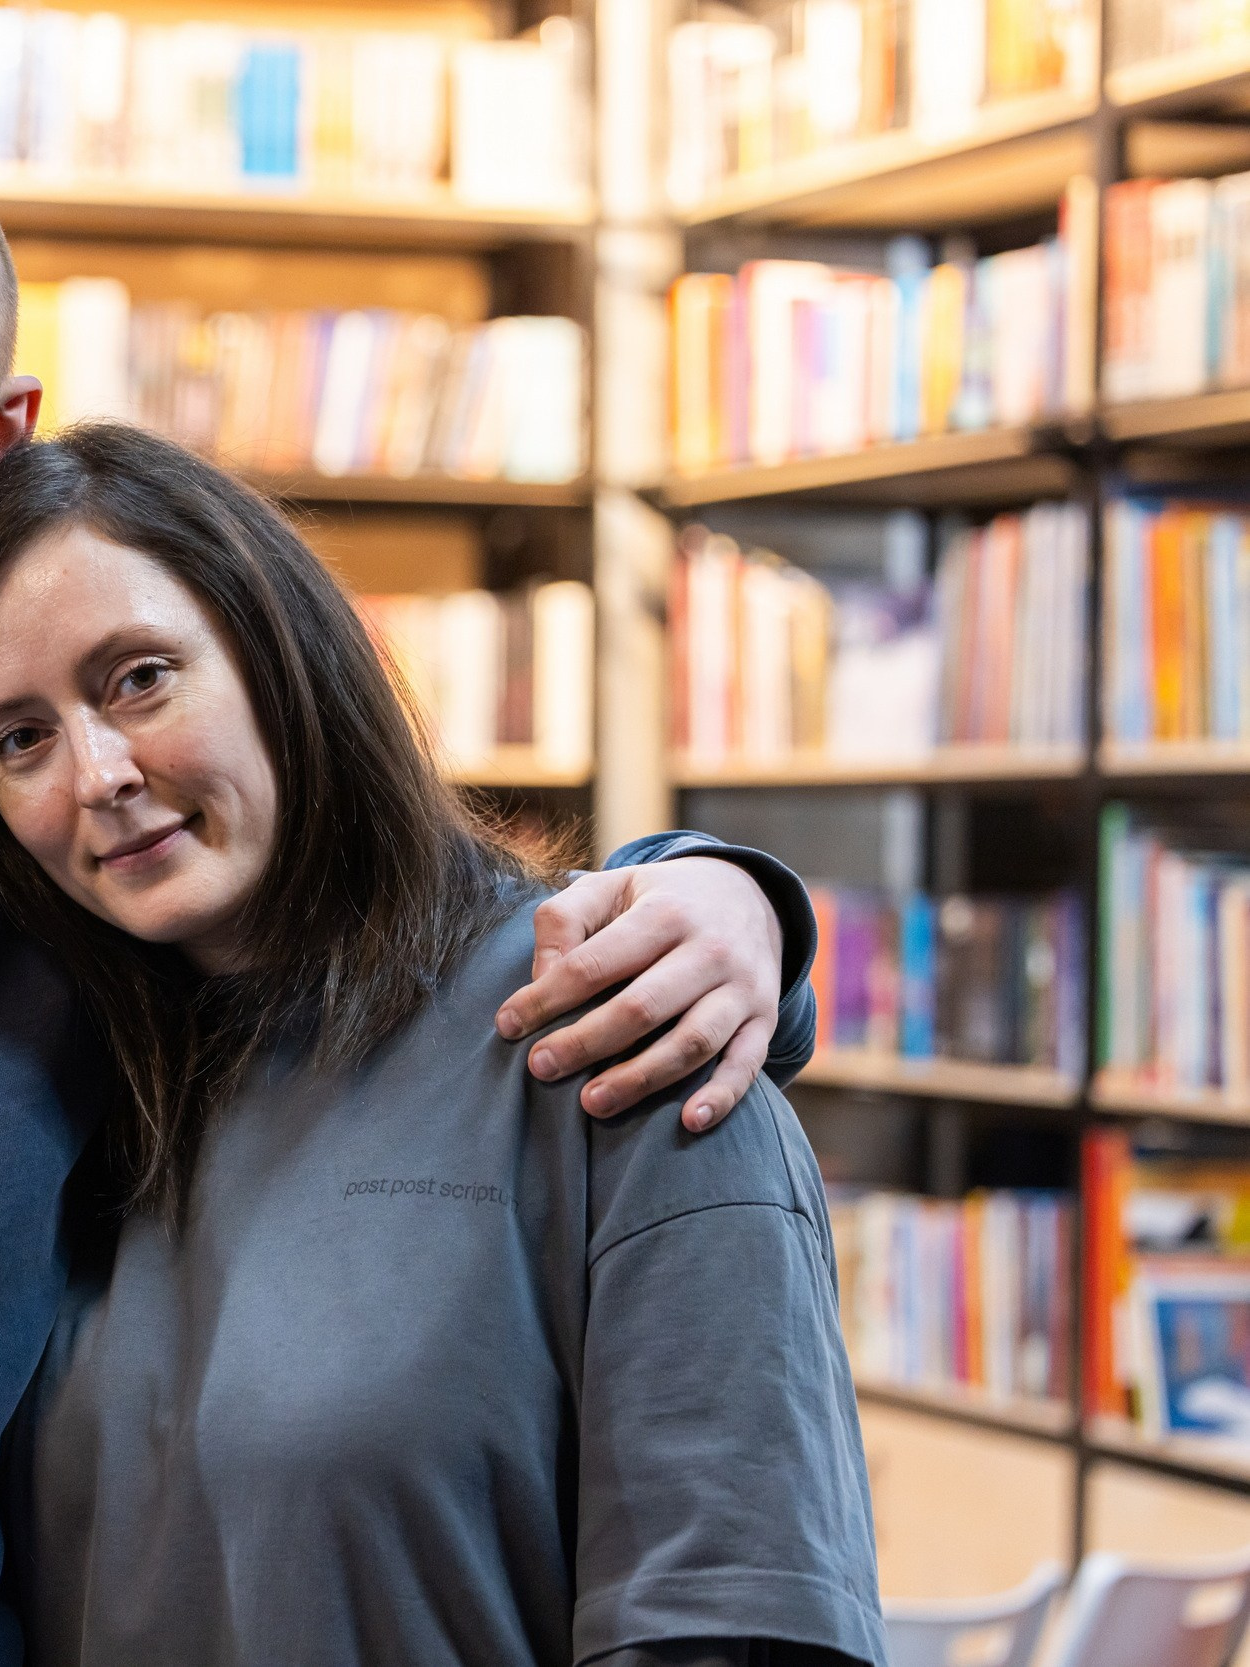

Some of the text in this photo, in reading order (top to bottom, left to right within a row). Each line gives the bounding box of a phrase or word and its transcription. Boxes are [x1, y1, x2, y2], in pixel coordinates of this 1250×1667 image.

[344, 1177, 518, 1210] post post scriptu
